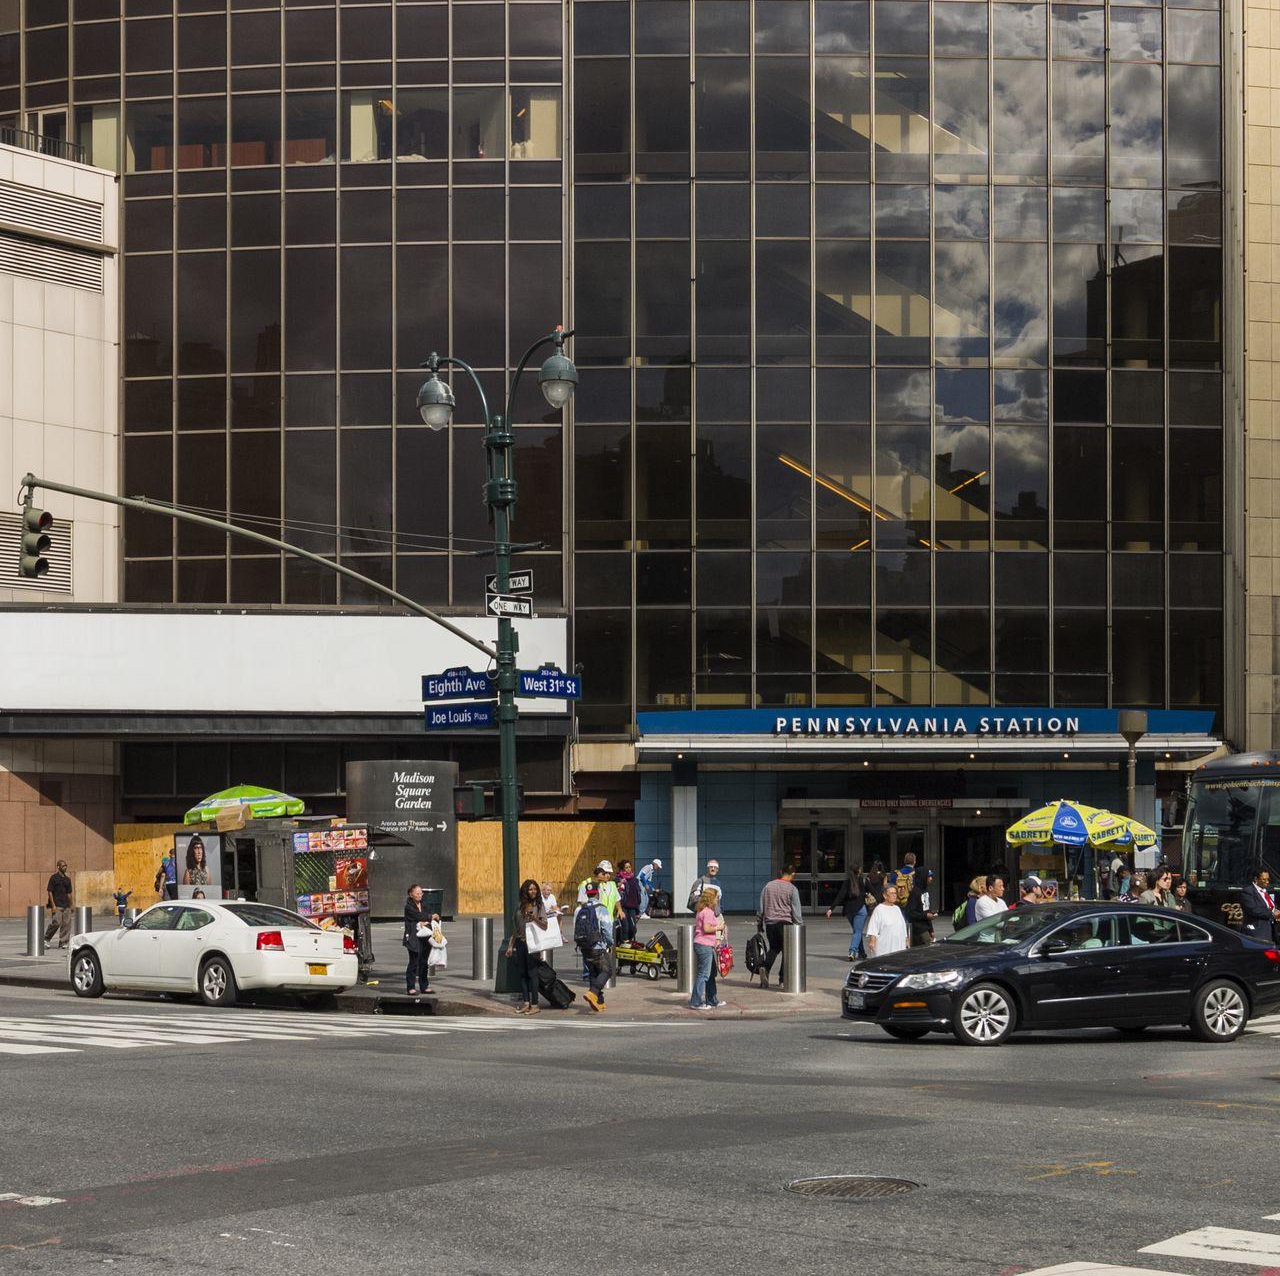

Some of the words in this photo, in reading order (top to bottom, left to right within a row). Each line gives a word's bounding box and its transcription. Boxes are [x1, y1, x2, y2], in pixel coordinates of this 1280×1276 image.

[511, 577, 527, 587] WAY
[493, 601, 507, 611] ONE
[513, 603, 527, 612] WAY
[429, 678, 462, 696] Eighth
[465, 675, 486, 691] Ave
[524, 677, 547, 692] West
[549, 680, 564, 693] 31st
[566, 681, 576, 694] St
[431, 711, 447, 724] Joe
[448, 708, 472, 723] Louis
[473, 711, 488, 720] Plaza
[776, 717, 968, 732] PENNSYLVANIA
[980, 717, 1079, 732] STATION
[392, 771, 435, 783] Madison
[395, 784, 432, 798] Square
[395, 797, 432, 809] Garden
[1009, 830, 1050, 839] SABRETT
[1091, 825, 1125, 842] SABRETT
